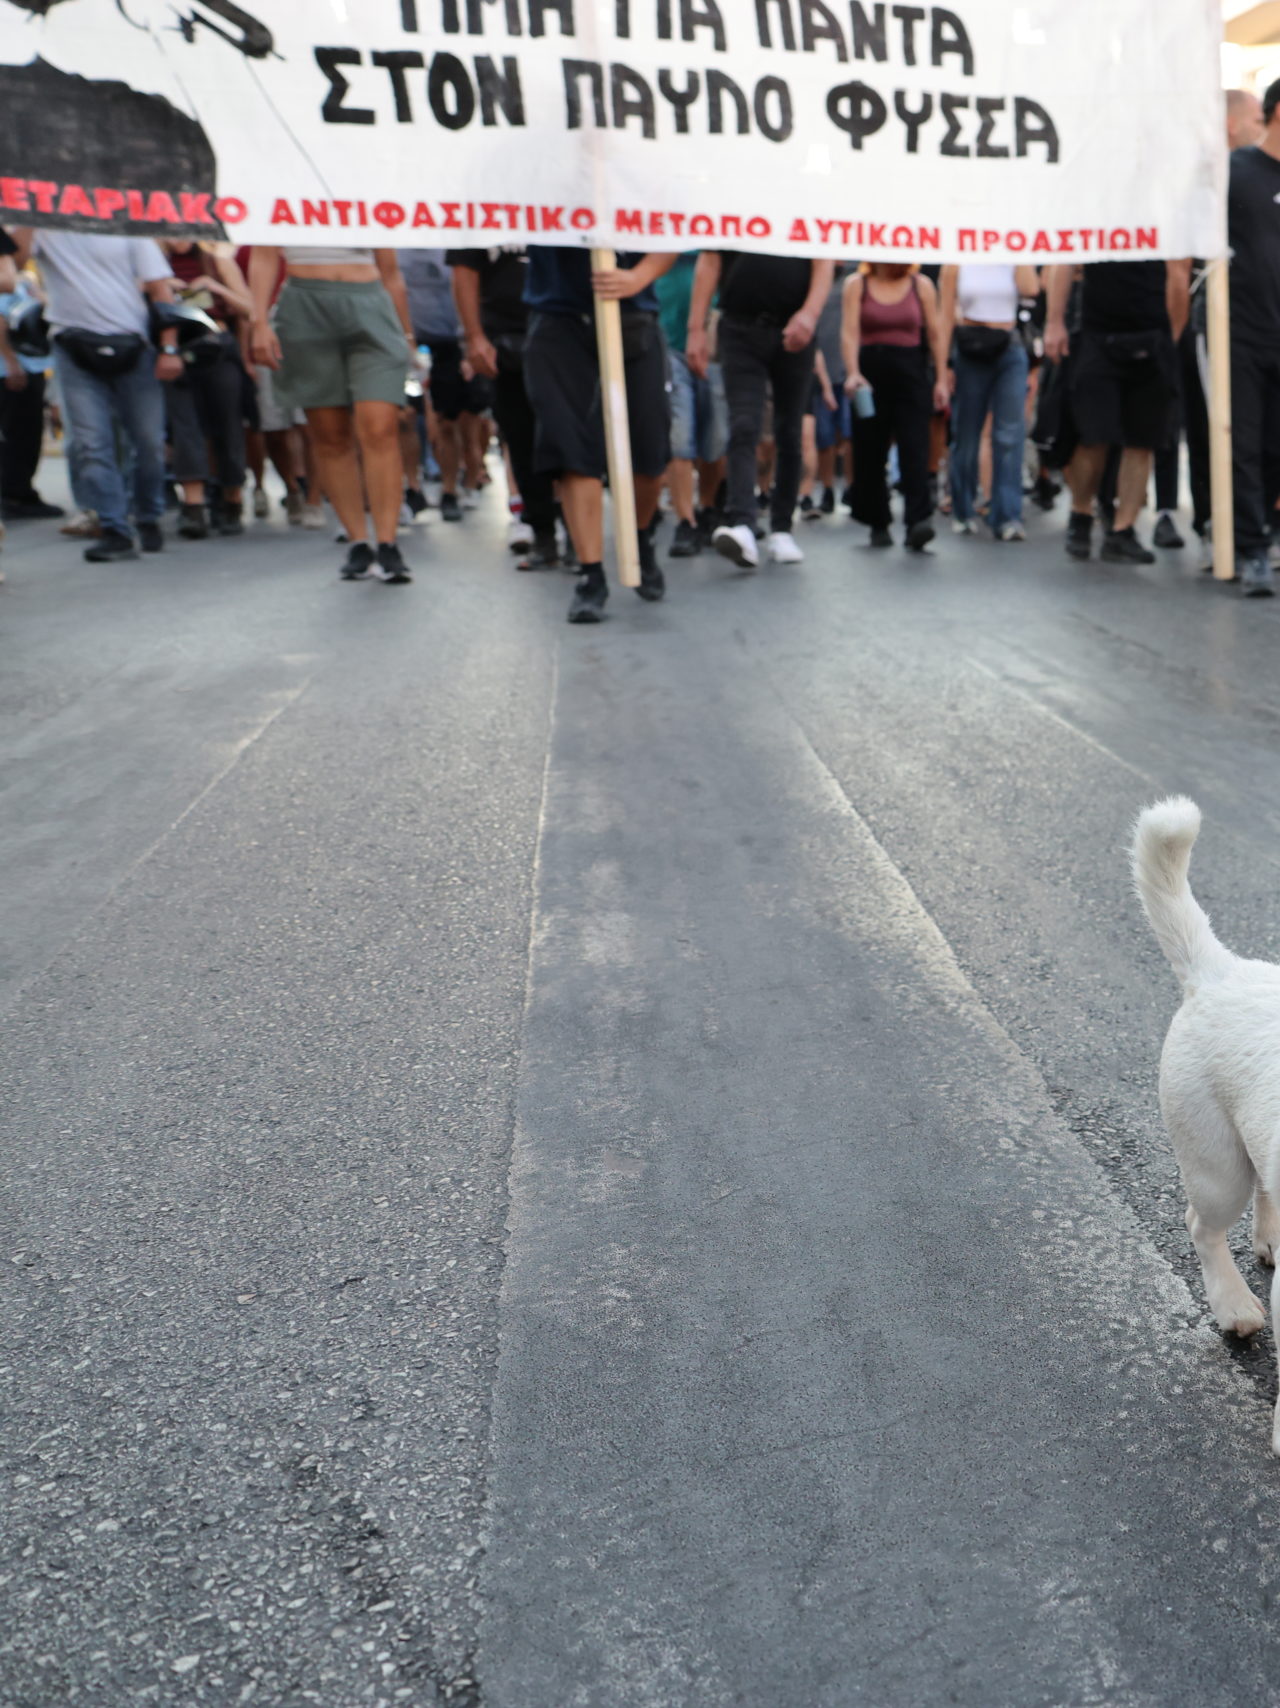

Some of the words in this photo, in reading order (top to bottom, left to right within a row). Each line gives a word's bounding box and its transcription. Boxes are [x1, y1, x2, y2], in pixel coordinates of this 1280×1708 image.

[753, 0, 975, 77] ΠΑΝΤΑ
[314, 46, 526, 131] ΣΤΟΝ
[561, 58, 794, 143] ΠΑΥΛΟ
[825, 79, 1060, 164] ΦΥΣΣΑ
[269, 198, 598, 233] ΑΝΤΙΦΑΣΙΣΤΙΚΟ
[614, 208, 772, 239] ΜΕΤΩΠΟ
[788, 217, 942, 252] ΔΥΤΙΚΩΝ
[956, 228, 1159, 254] ΠΡΟΑΣΤΙΩΝ
